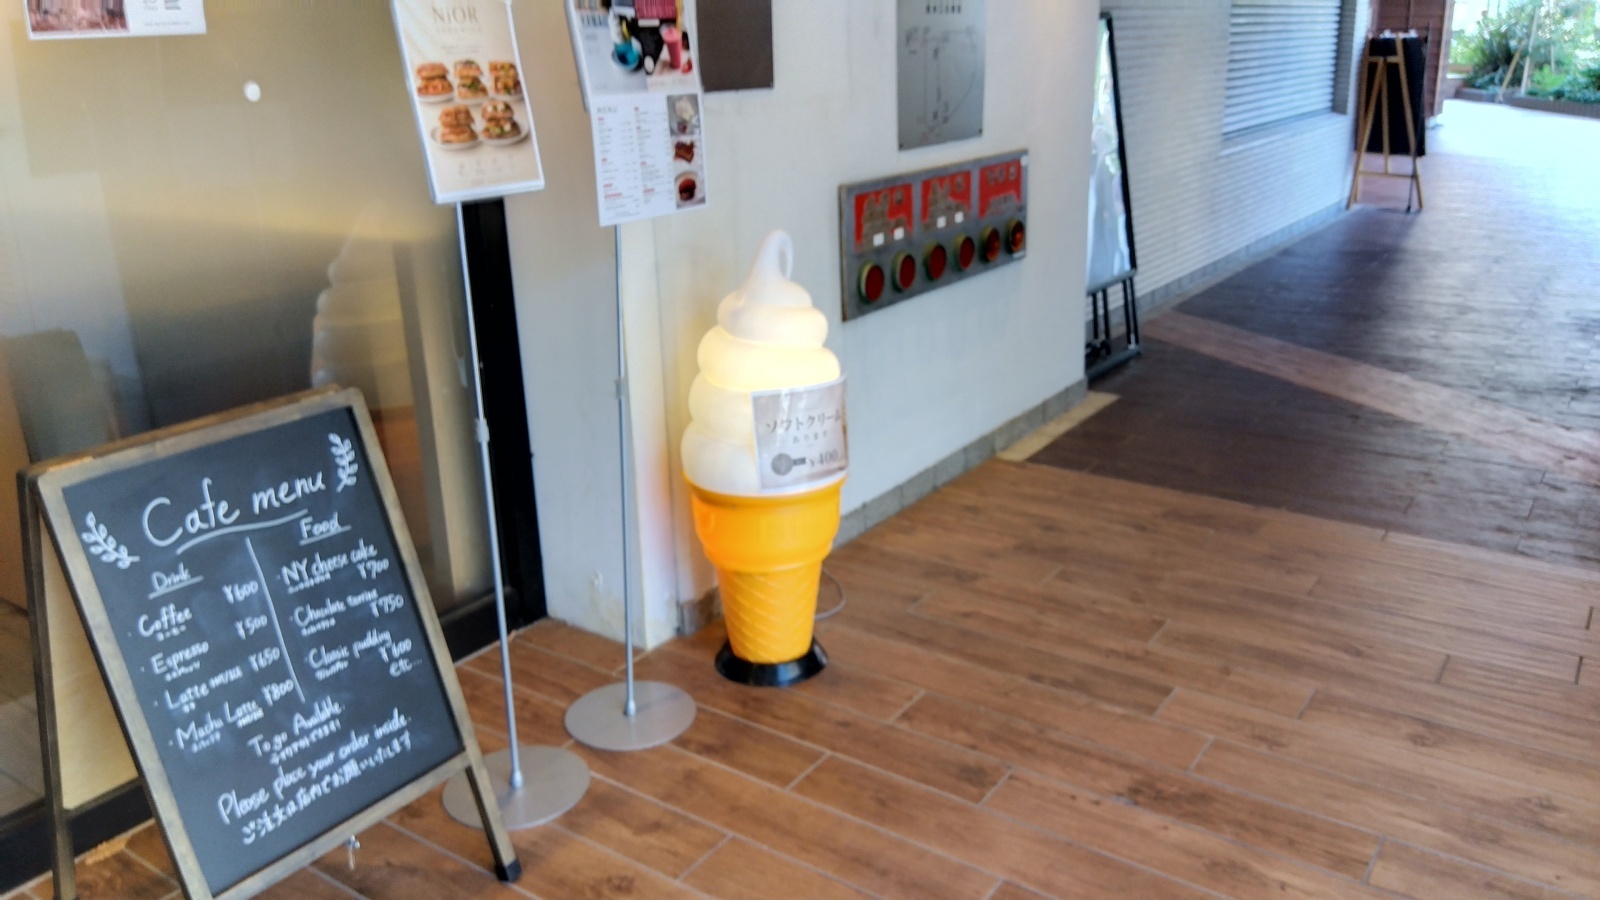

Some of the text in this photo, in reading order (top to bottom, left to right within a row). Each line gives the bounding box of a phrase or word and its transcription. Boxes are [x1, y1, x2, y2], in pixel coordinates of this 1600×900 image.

[142, 471, 325, 547] Cafe menu
[300, 511, 342, 540] Food
[151, 562, 191, 592] Drink
[281, 557, 309, 587] NY
[350, 538, 378, 563] cake
[138, 602, 192, 637] Coffee
[222, 580, 259, 604] ¥600
[150, 641, 209, 675] Espresso
[234, 614, 268, 640] ¥500
[164, 683, 209, 711] Latte
[261, 679, 294, 707] ¥800
[217, 788, 269, 825] Please
[273, 765, 306, 800] place
[308, 751, 335, 779] your
[338, 730, 370, 760] order
